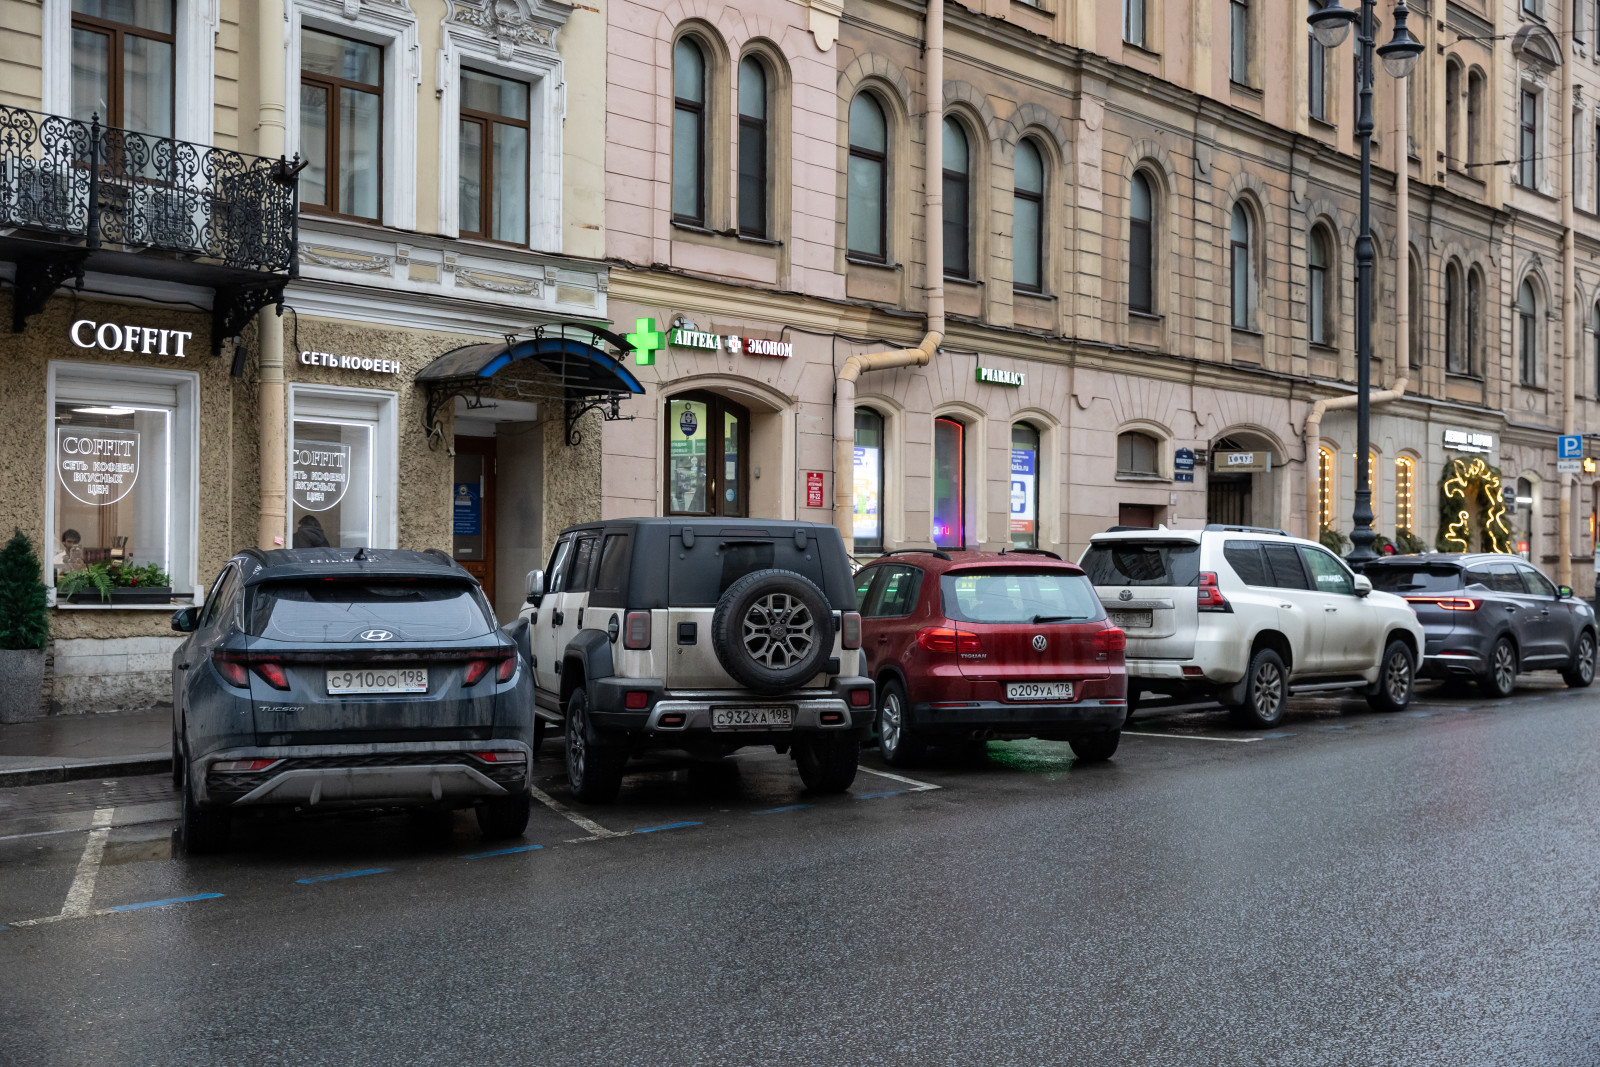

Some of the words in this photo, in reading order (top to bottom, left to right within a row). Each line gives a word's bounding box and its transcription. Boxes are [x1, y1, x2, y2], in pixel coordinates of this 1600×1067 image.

[70, 319, 192, 358] COFFIT
[674, 329, 721, 350] АПТЕКА
[748, 338, 793, 357] ЭКОНОМ
[301, 350, 339, 368] СЕТЬ
[341, 355, 400, 374] КОФЕЕН
[981, 367, 1026, 386] PHARMACY
[62, 436, 135, 457] COFFIT
[62, 459, 89, 471] СЕТЬ
[93, 461, 135, 473] КОФЕЕН
[73, 471, 123, 484] ВКУСНЫХ
[311, 471, 346, 483] КОФЕЕН
[87, 484, 109, 496] ЦЕН
[294, 480, 337, 492] ВКУСНЫХ
[306, 491, 325, 503] ЦЕН
[400, 670, 424, 683] 198
[1055, 683, 1070, 693] 178
[769, 709, 789, 720] 198
